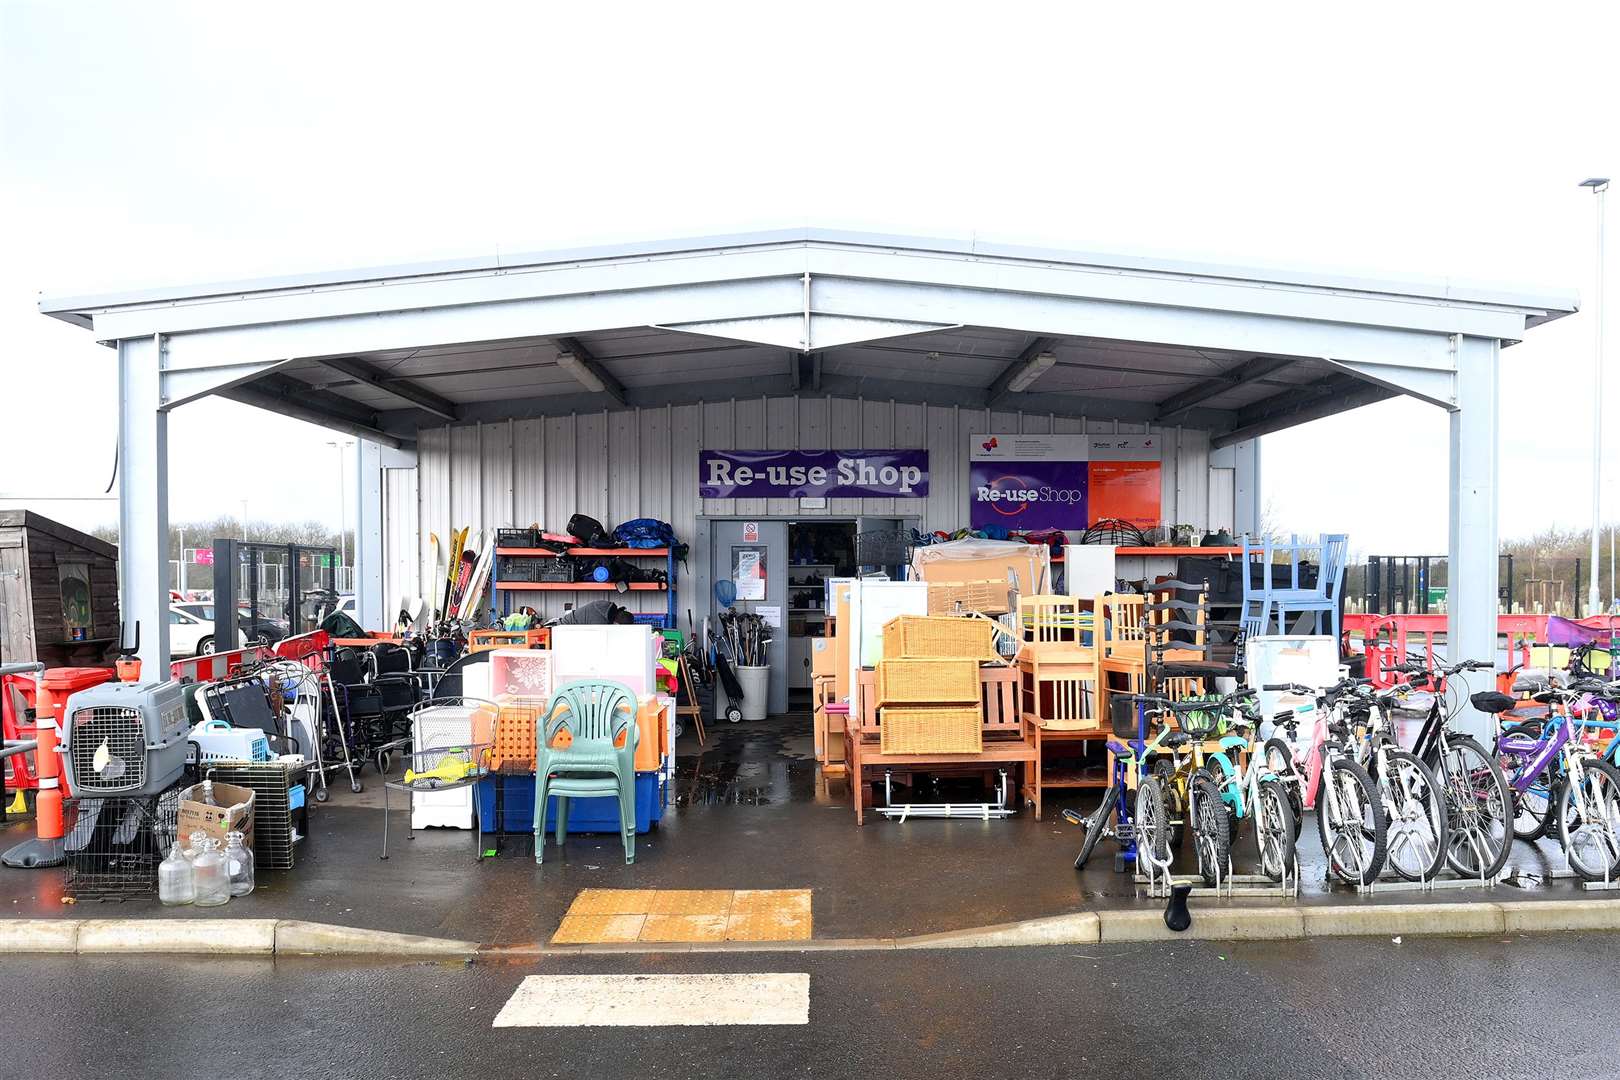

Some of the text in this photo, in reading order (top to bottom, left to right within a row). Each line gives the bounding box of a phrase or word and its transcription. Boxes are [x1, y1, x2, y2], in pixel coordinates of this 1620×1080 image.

[707, 458, 922, 493] Re-use Shop
[977, 486, 1082, 505] Re-use Shop
